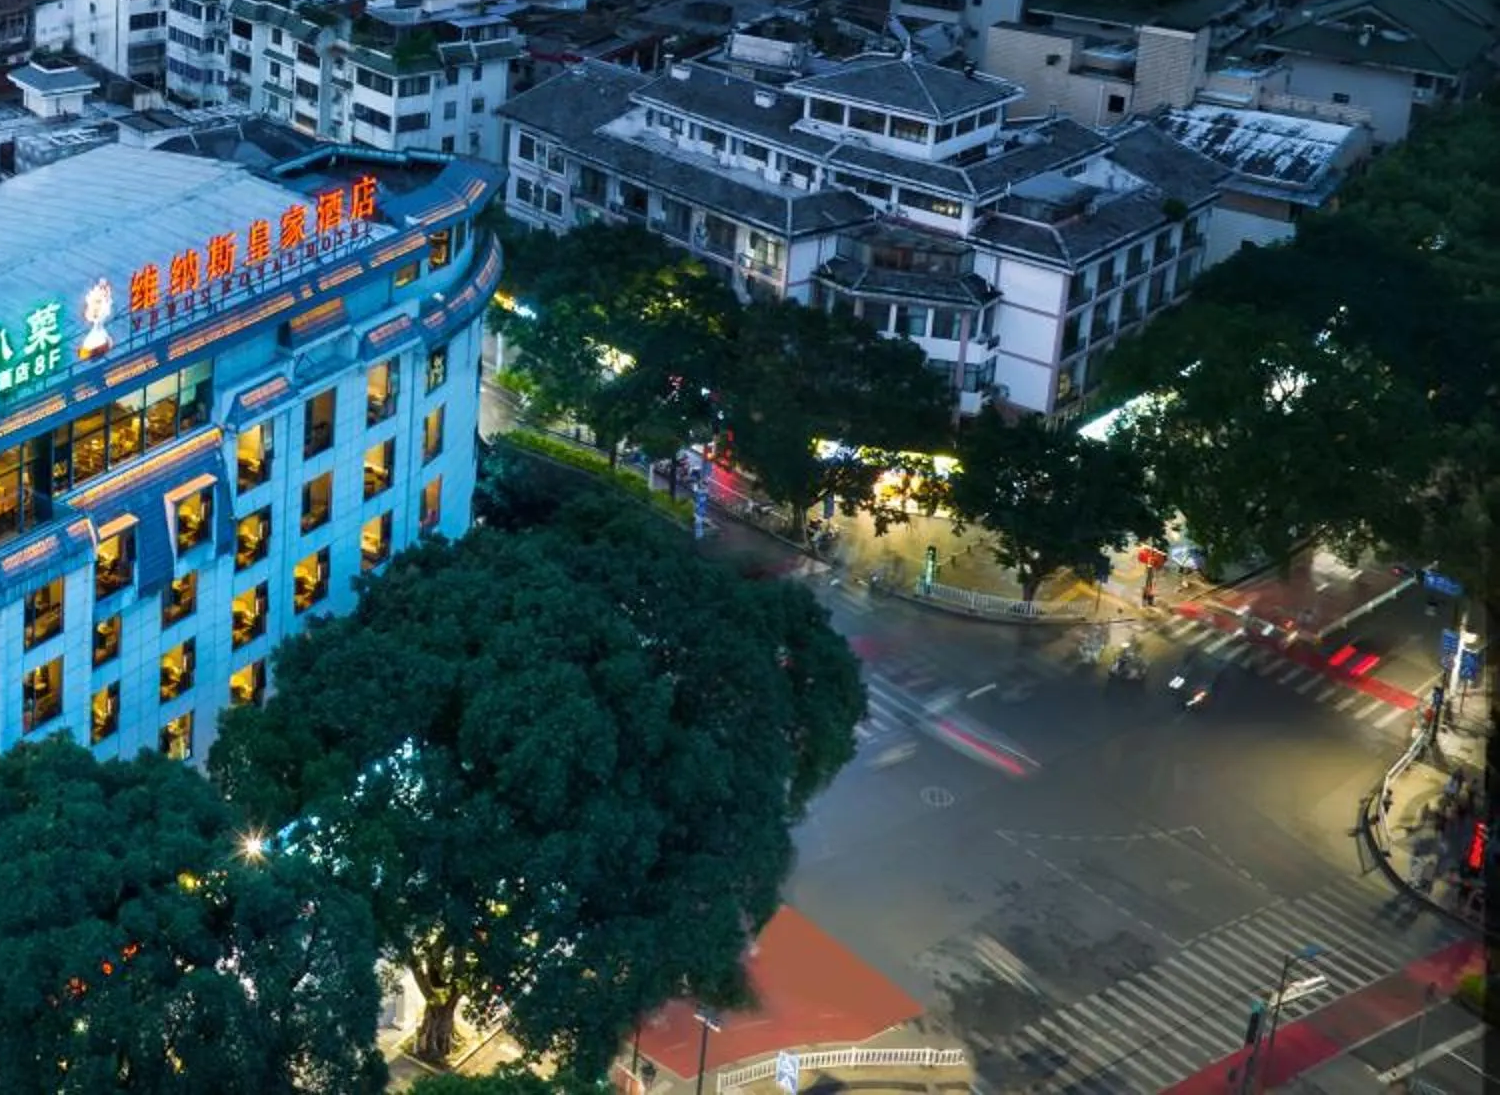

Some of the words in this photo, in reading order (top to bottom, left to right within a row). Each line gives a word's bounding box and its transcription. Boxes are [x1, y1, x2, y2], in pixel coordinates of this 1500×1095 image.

[130, 174, 377, 313] 维纳斯皇家酒店
